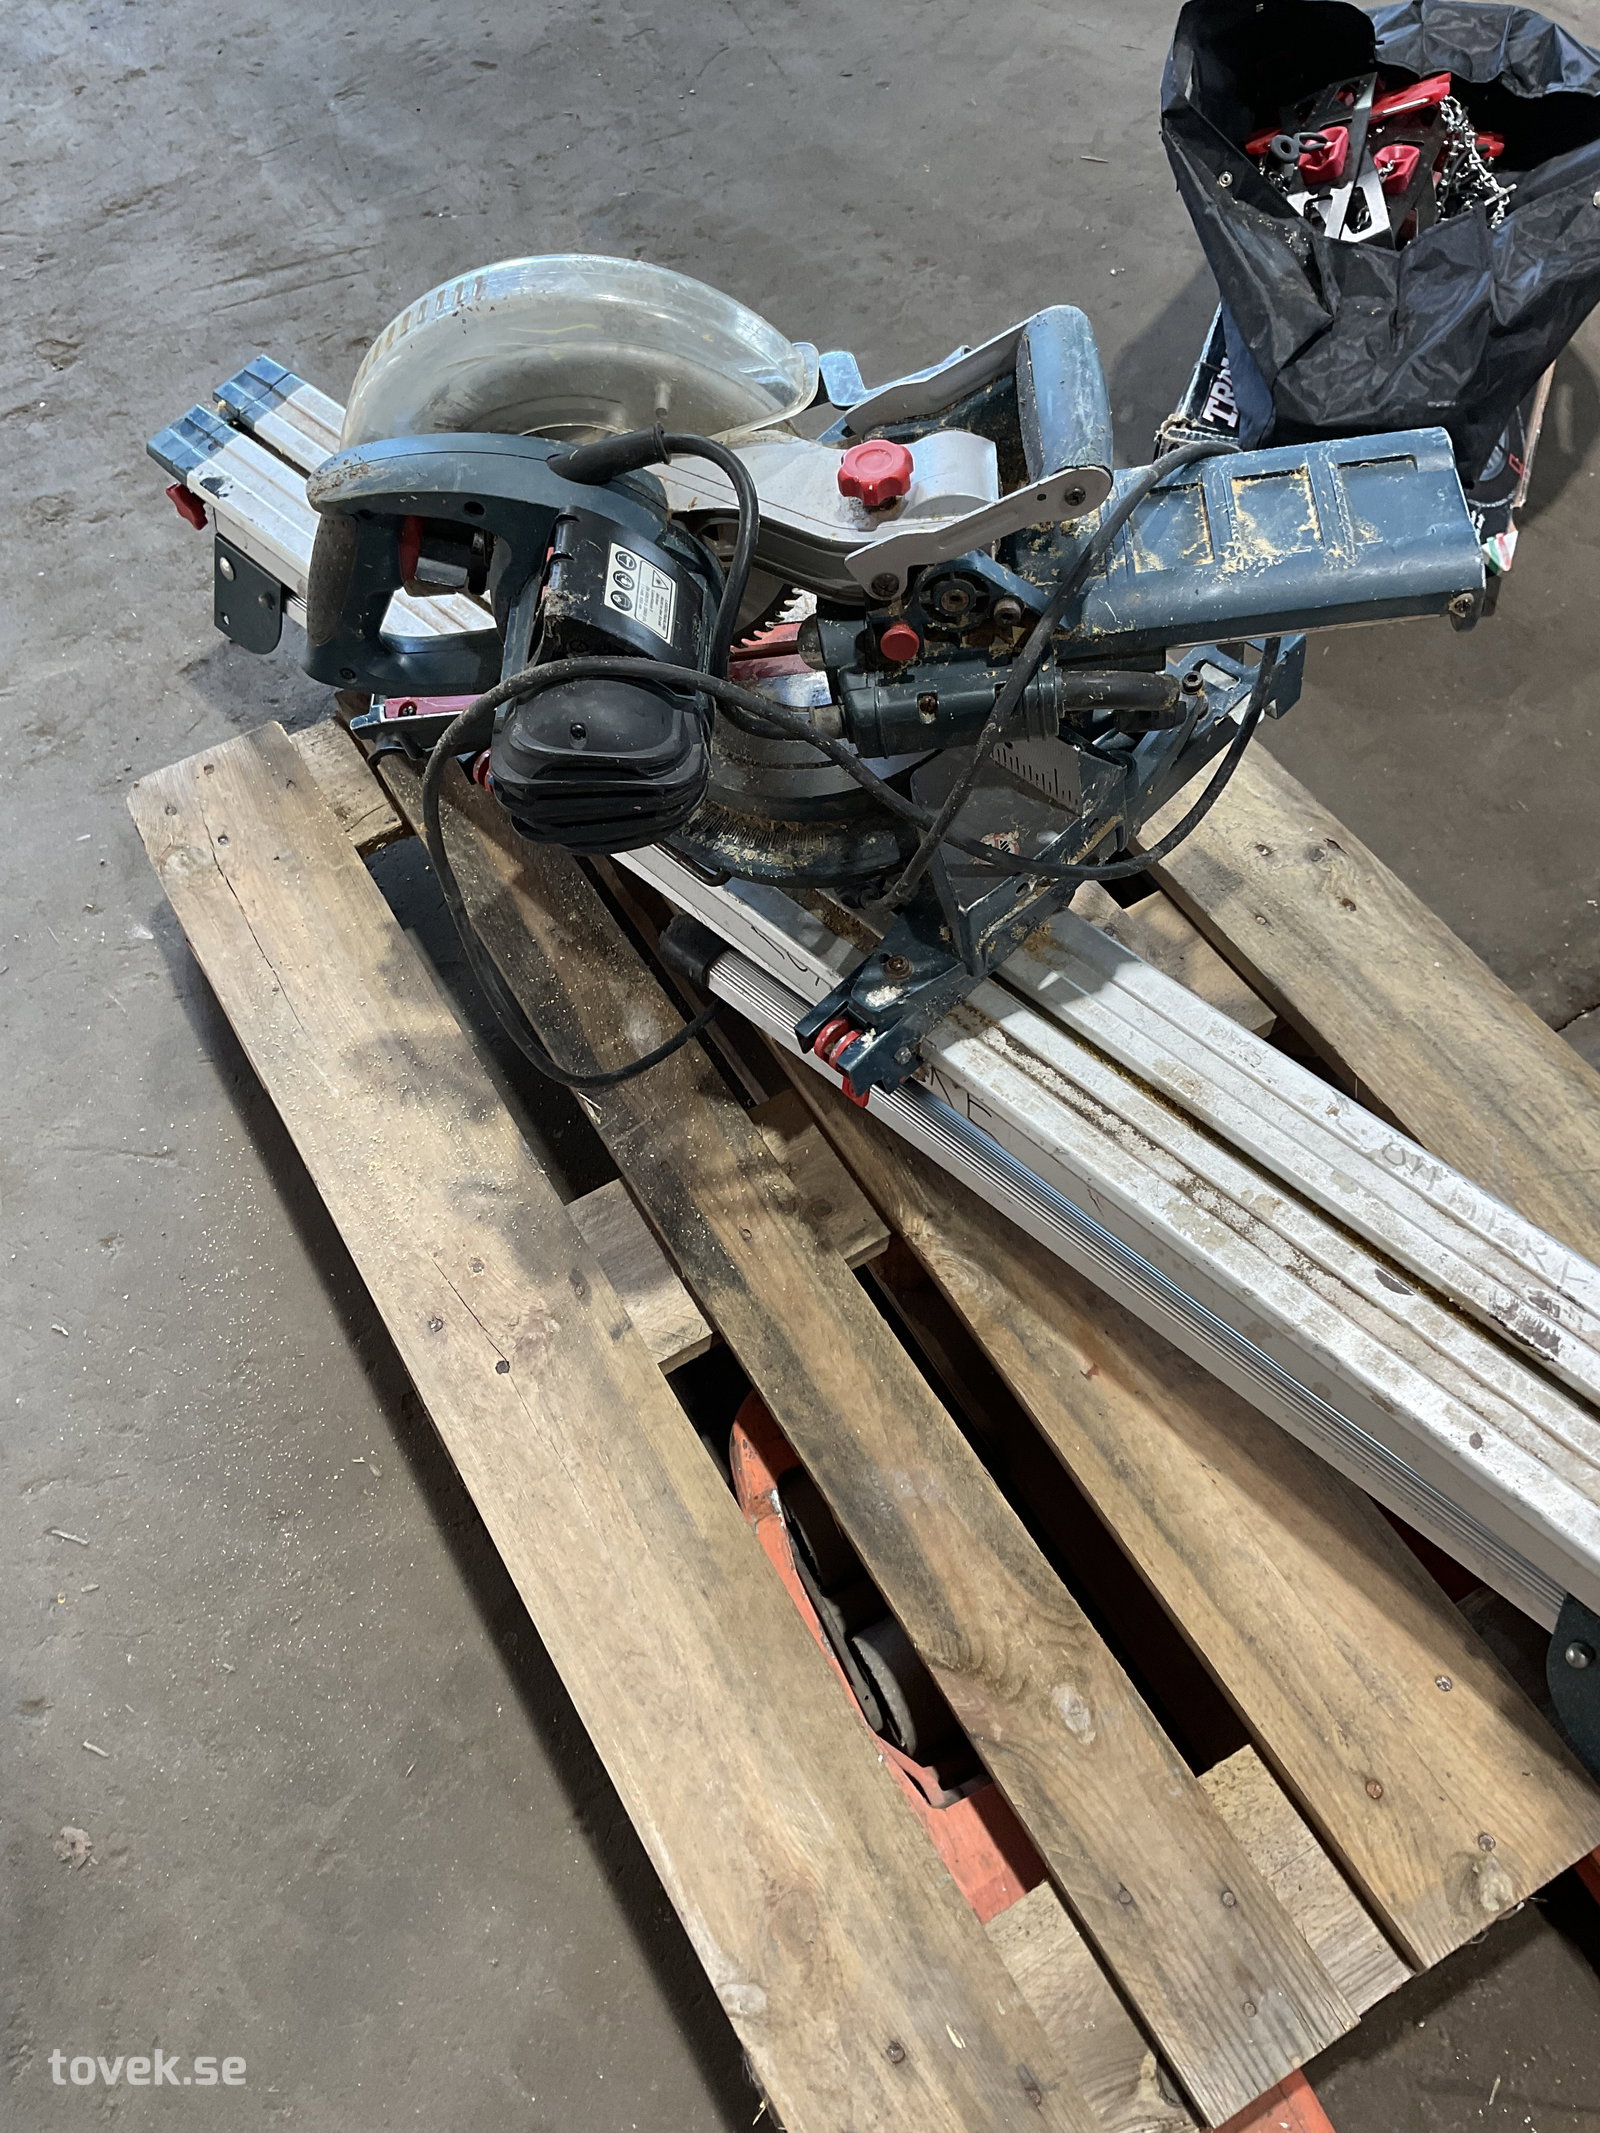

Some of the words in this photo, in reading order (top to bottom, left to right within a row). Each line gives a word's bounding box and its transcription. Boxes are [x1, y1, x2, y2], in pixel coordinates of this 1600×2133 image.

[1201, 357, 1240, 428] TR
[722, 844, 740, 857] 35
[760, 852, 774, 864] 45
